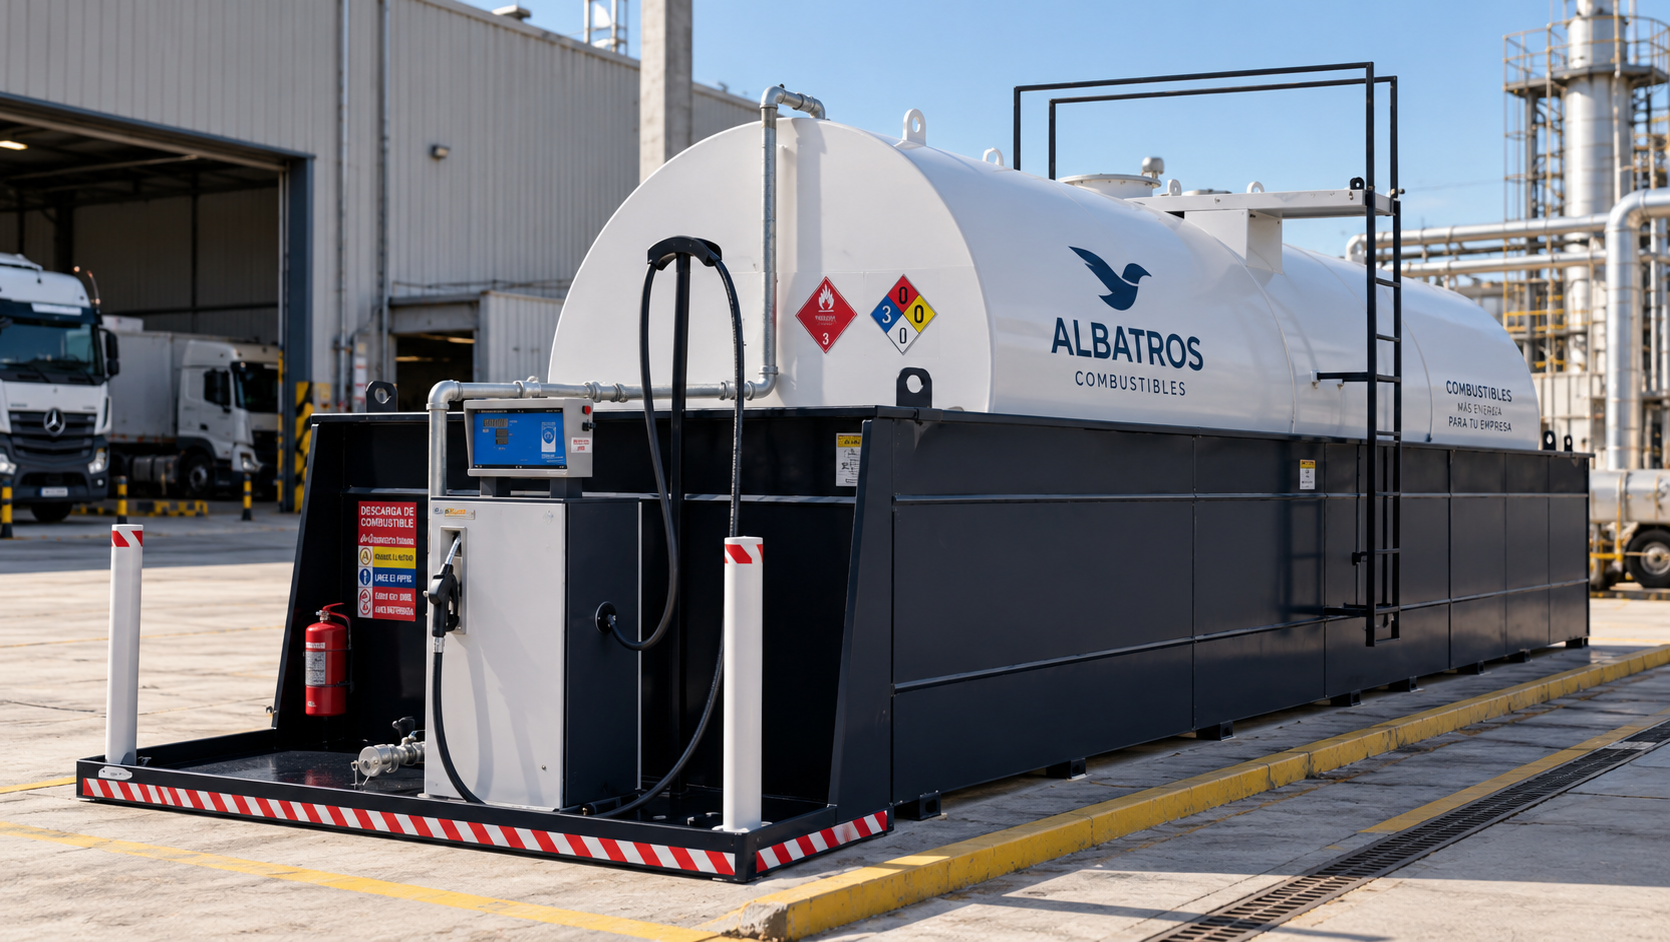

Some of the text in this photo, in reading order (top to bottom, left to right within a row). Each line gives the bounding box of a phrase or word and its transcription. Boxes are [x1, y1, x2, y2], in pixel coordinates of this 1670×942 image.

[898, 286, 908, 304] 0
[882, 305, 924, 323] 3 0
[822, 332, 830, 346] 3
[899, 327, 908, 344] 0
[1051, 317, 1204, 371] ALBATROS
[1075, 370, 1186, 396] COMBUSTIBLES
[1446, 380, 1512, 402] COMBUSTIBLES
[1448, 416, 1512, 432] PARA TU EMPRESA
[361, 506, 414, 516] DESCARGA DE
[361, 518, 414, 528] COMBUSTIBLE
